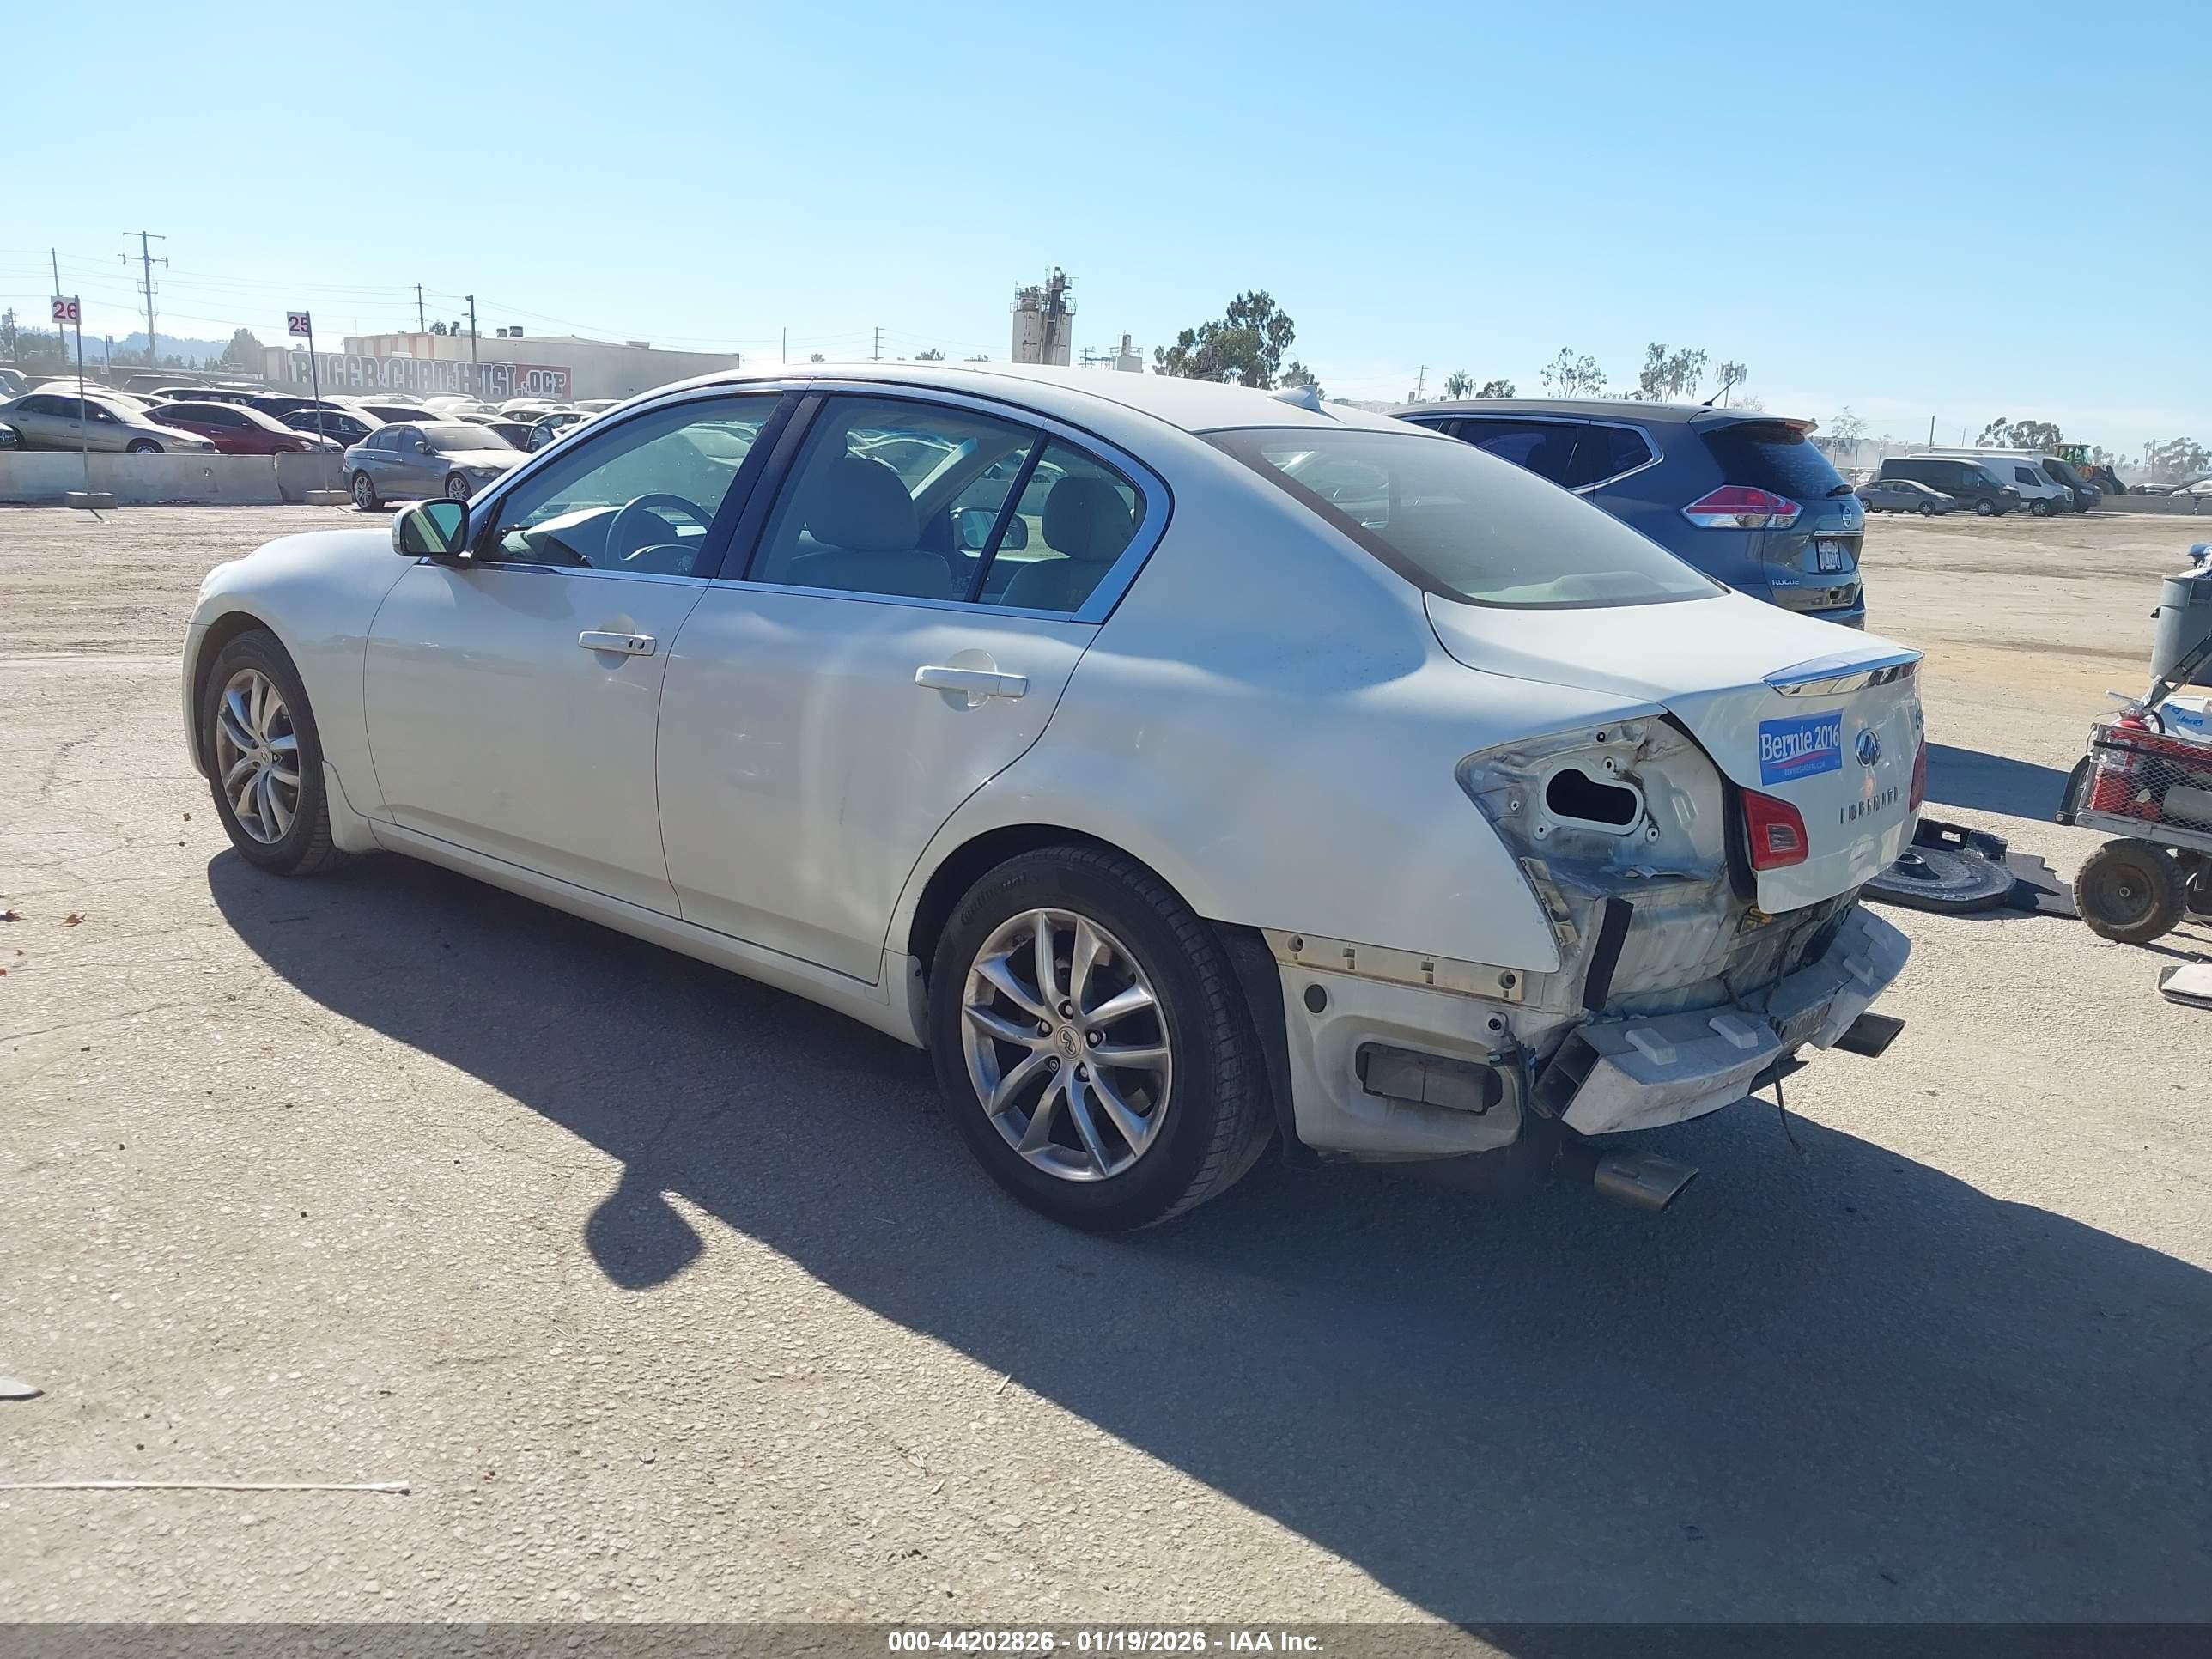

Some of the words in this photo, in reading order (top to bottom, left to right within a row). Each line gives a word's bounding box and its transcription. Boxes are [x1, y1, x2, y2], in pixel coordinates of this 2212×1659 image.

[53, 301, 77, 320] 26
[289, 316, 310, 333] 25
[1761, 726, 1812, 761] Bernie
[1814, 723, 1840, 750] 2016
